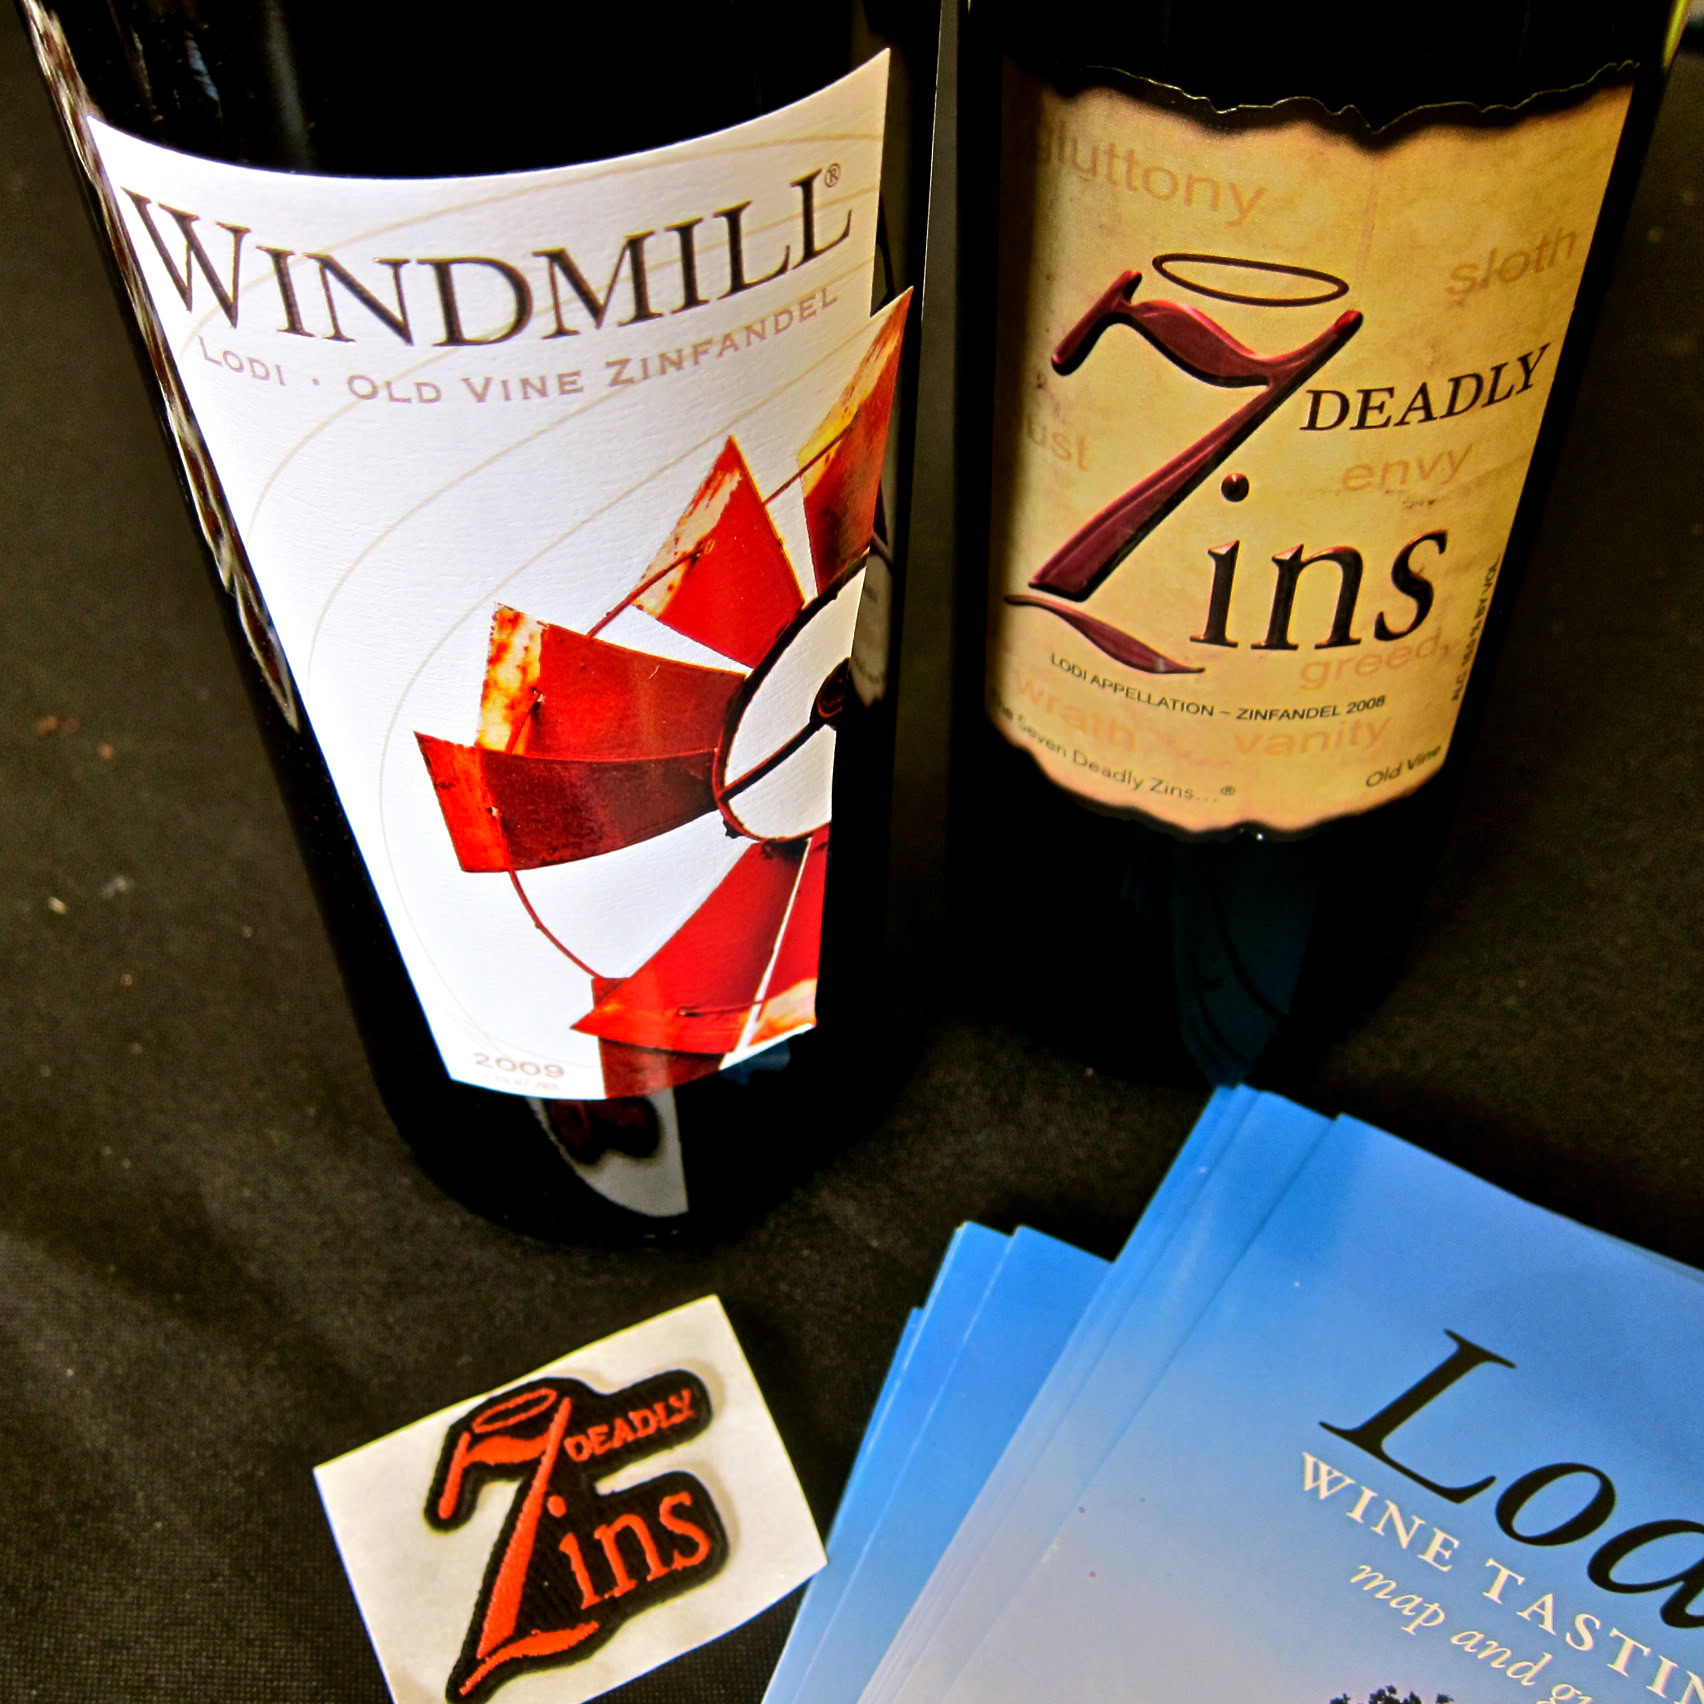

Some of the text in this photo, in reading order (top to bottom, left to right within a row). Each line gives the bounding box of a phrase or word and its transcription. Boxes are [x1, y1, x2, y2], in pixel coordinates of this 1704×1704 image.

[1034, 118, 1267, 227] luttony
[1445, 225, 1577, 296] sloth
[197, 287, 839, 404] LODI OLD VINE ZINFANDEL
[1299, 343, 1550, 432] DEADLY
[1022, 412, 1091, 472] ust
[1342, 443, 1472, 494] envy
[1016, 679, 1136, 752] wrath
[1051, 652, 1386, 721] LODI APPELLATION ZINFANDEL 2008
[1018, 714, 1067, 758] Seven
[1073, 749, 1144, 791] Deadly
[1233, 716, 1391, 756] vanity
[1365, 744, 1442, 788] Old Vine
[472, 1051, 566, 1079] 2009
[563, 1388, 696, 1462] DEADLY
[1302, 1451, 1461, 1572] WINE
[1350, 1563, 1446, 1636] map
[1450, 1630, 1552, 1687] and
